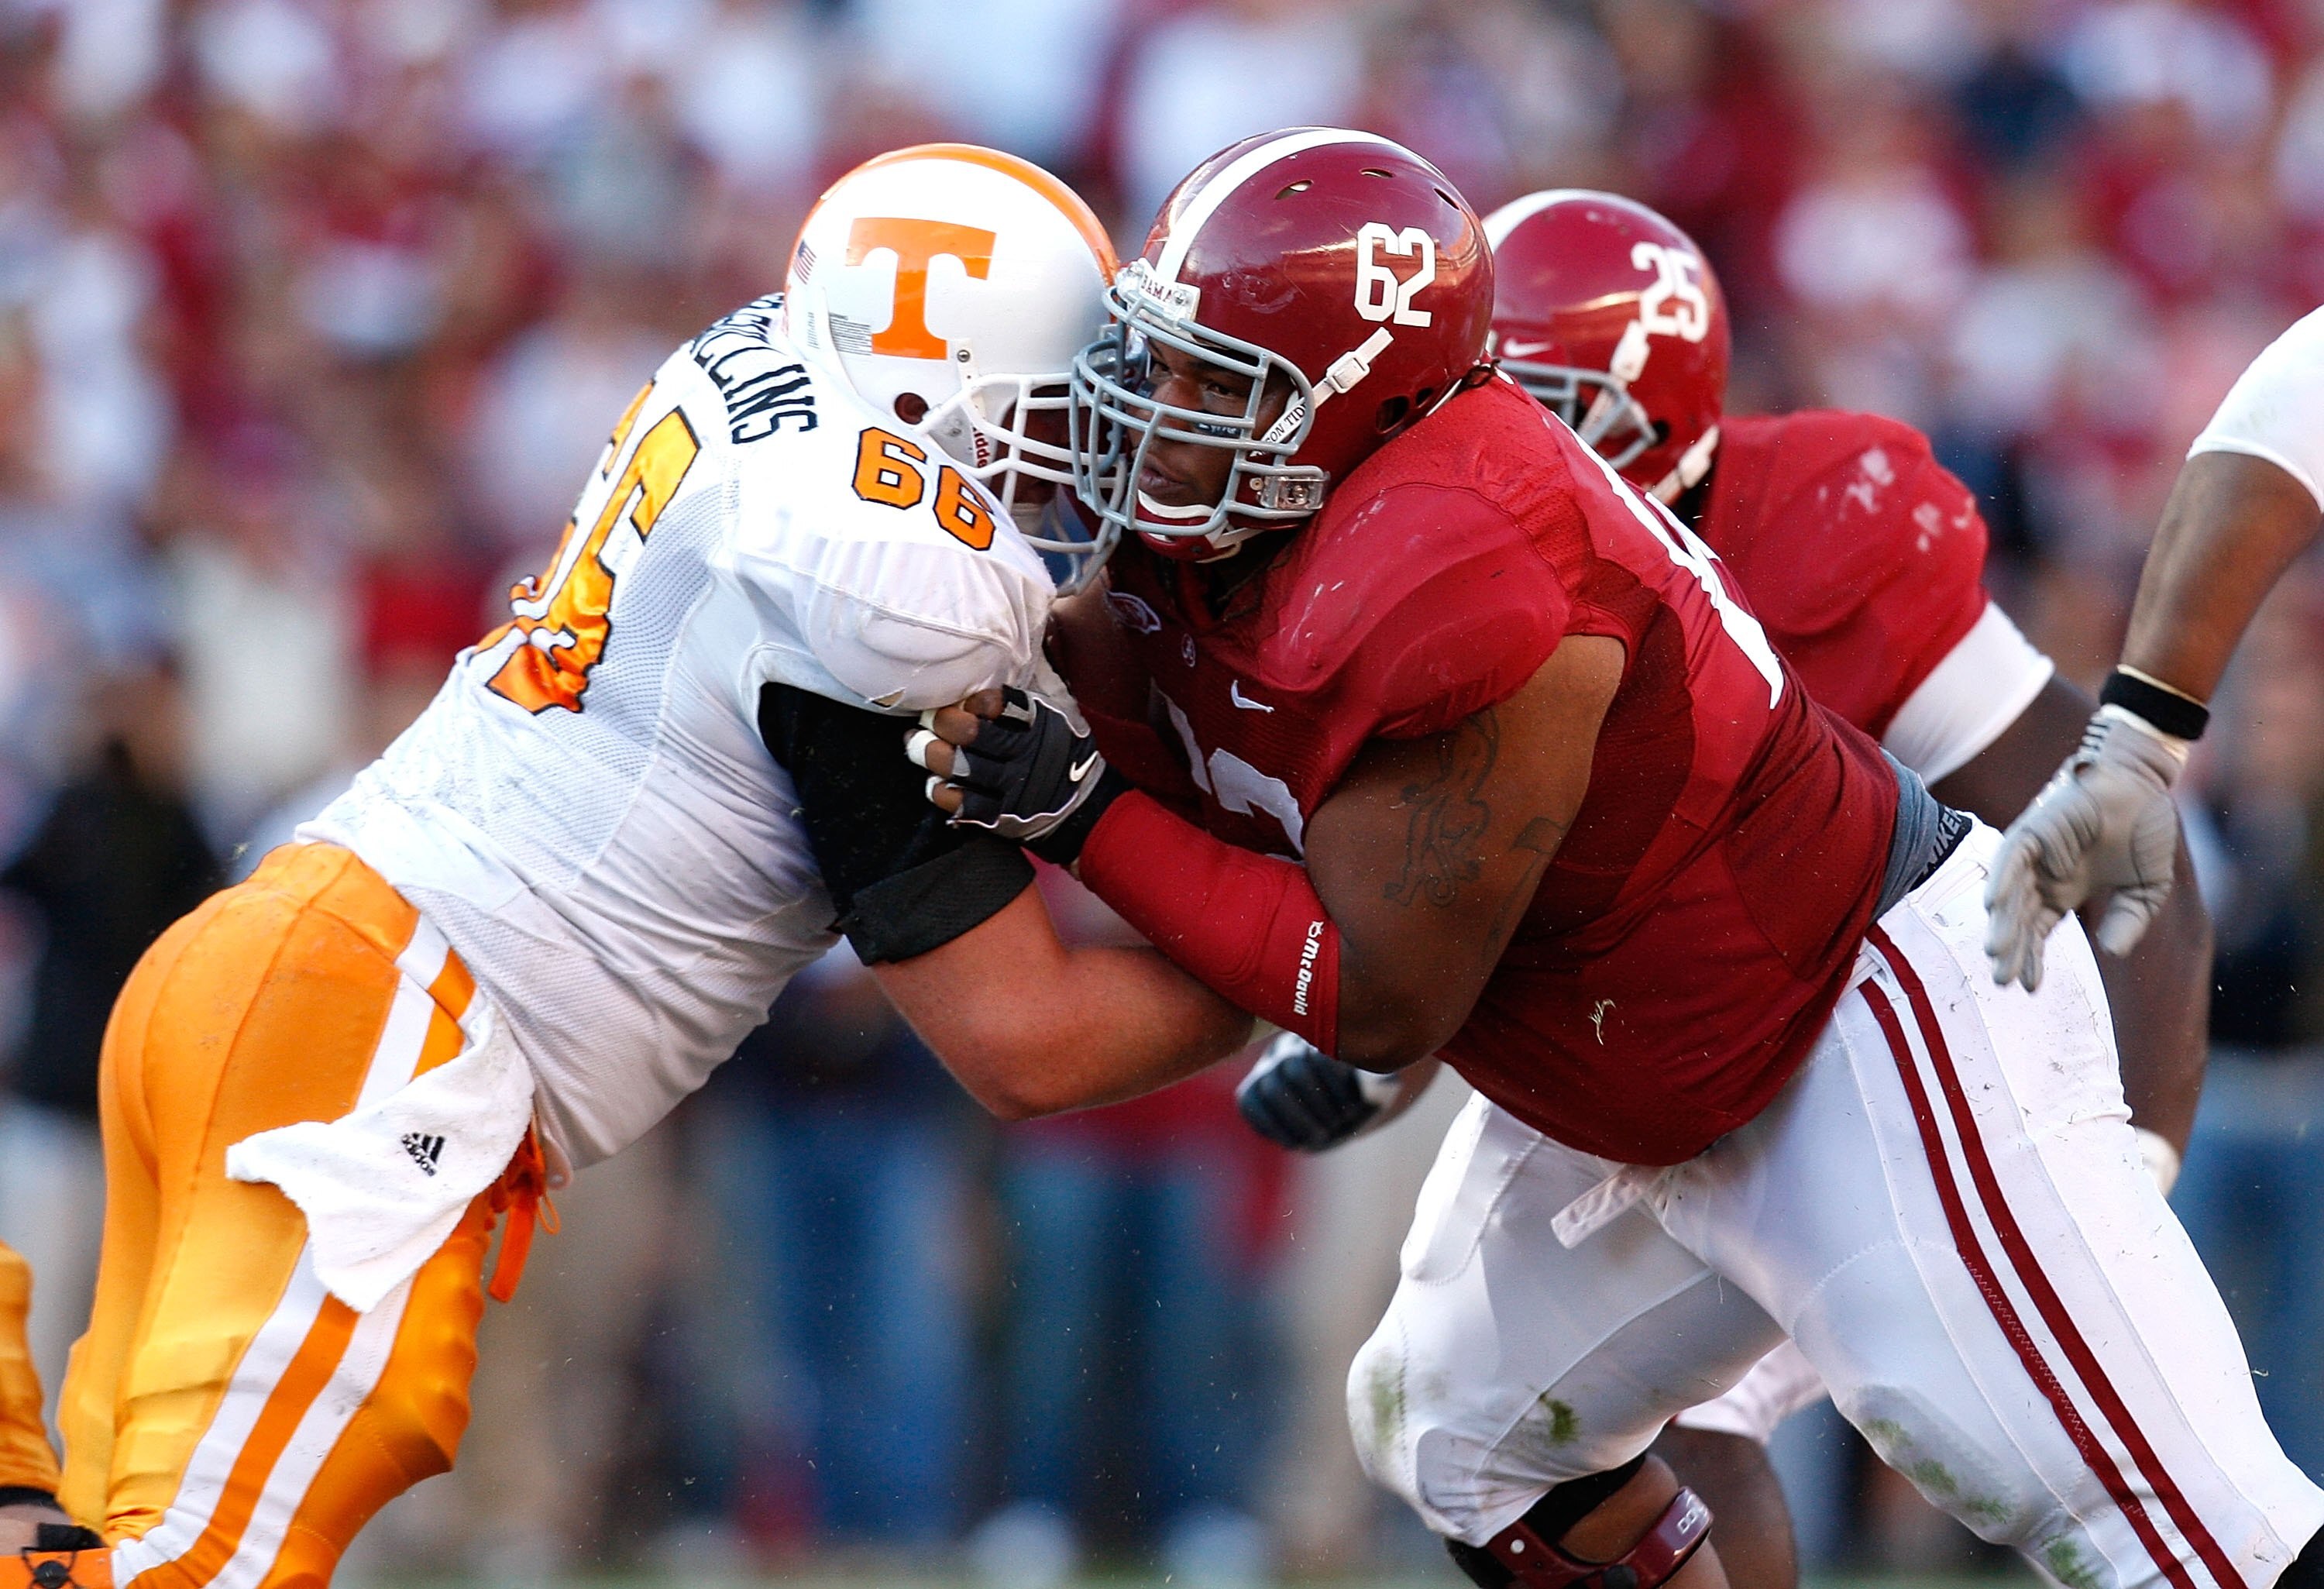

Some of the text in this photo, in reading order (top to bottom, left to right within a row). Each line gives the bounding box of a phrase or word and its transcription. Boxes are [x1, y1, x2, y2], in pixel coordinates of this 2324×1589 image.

[844, 217, 997, 360] T
[1354, 222, 1436, 328] 62
[1631, 241, 1708, 342] 25
[851, 426, 996, 551] 66
[972, 427, 990, 469] idde
[1293, 937, 1320, 1016] McDavid
[402, 1133, 435, 1177] adidas
